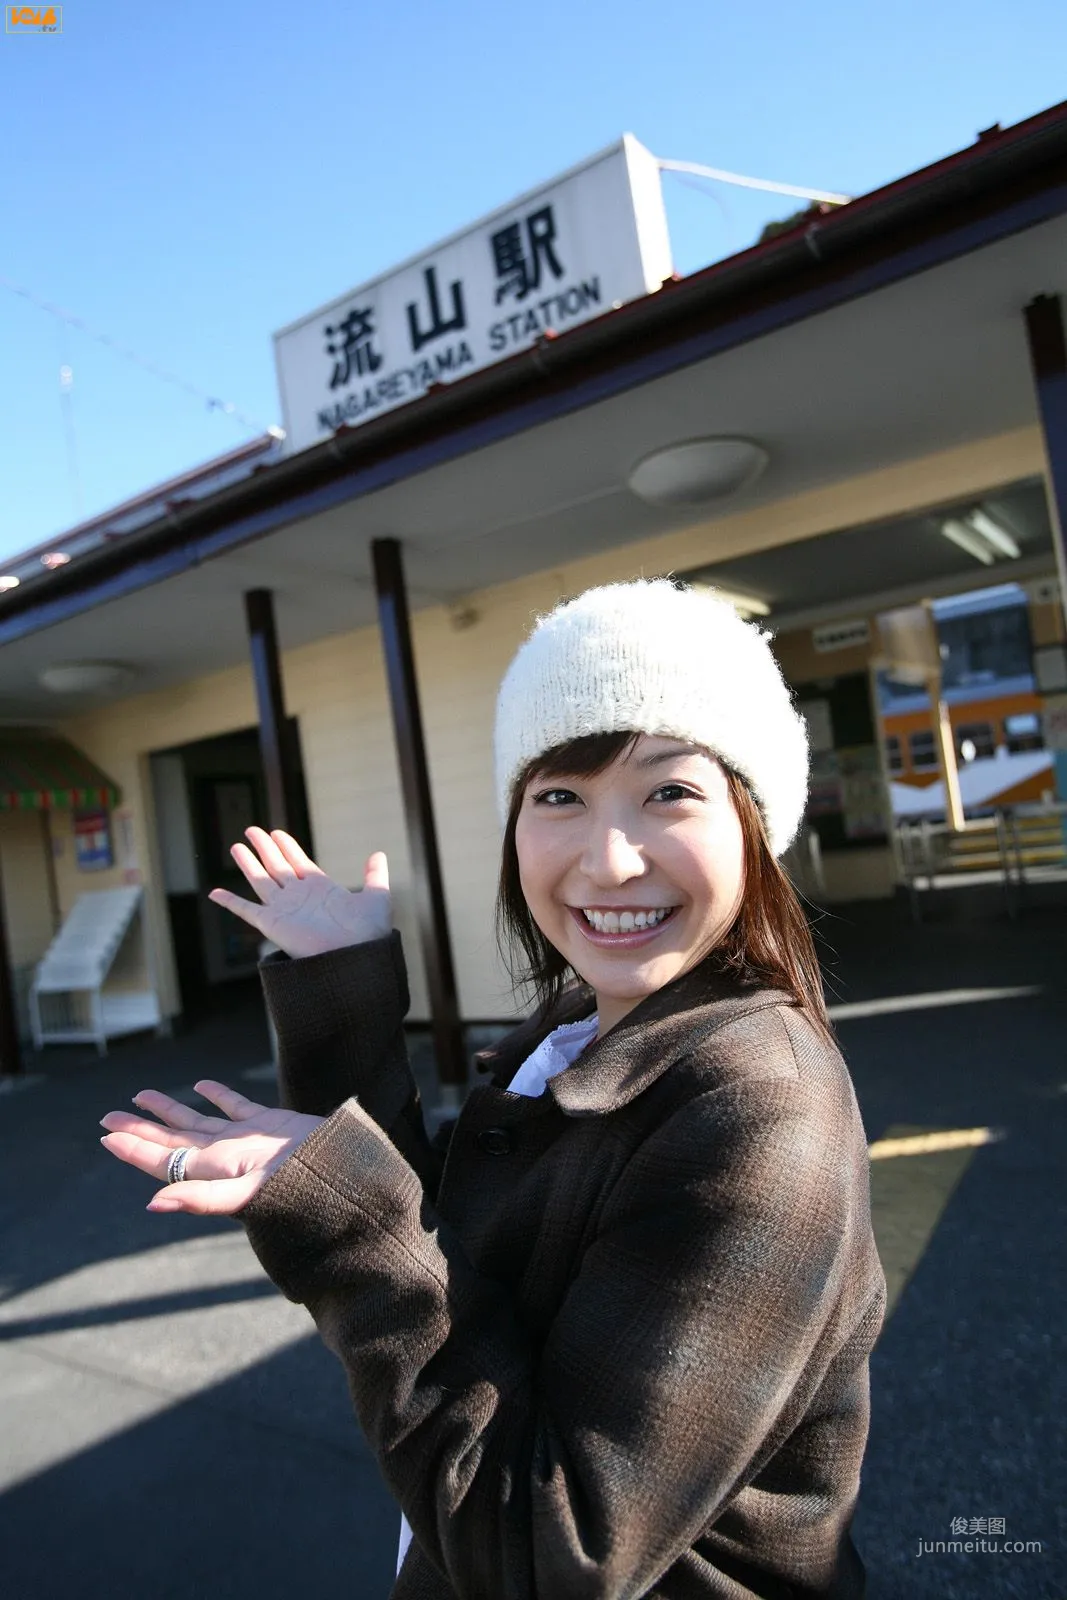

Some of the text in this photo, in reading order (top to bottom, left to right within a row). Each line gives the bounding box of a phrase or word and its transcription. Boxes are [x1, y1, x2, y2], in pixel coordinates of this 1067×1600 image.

[317, 275, 601, 431] NAGAREYAMA STATION
[324, 204, 564, 390] 流山駅
